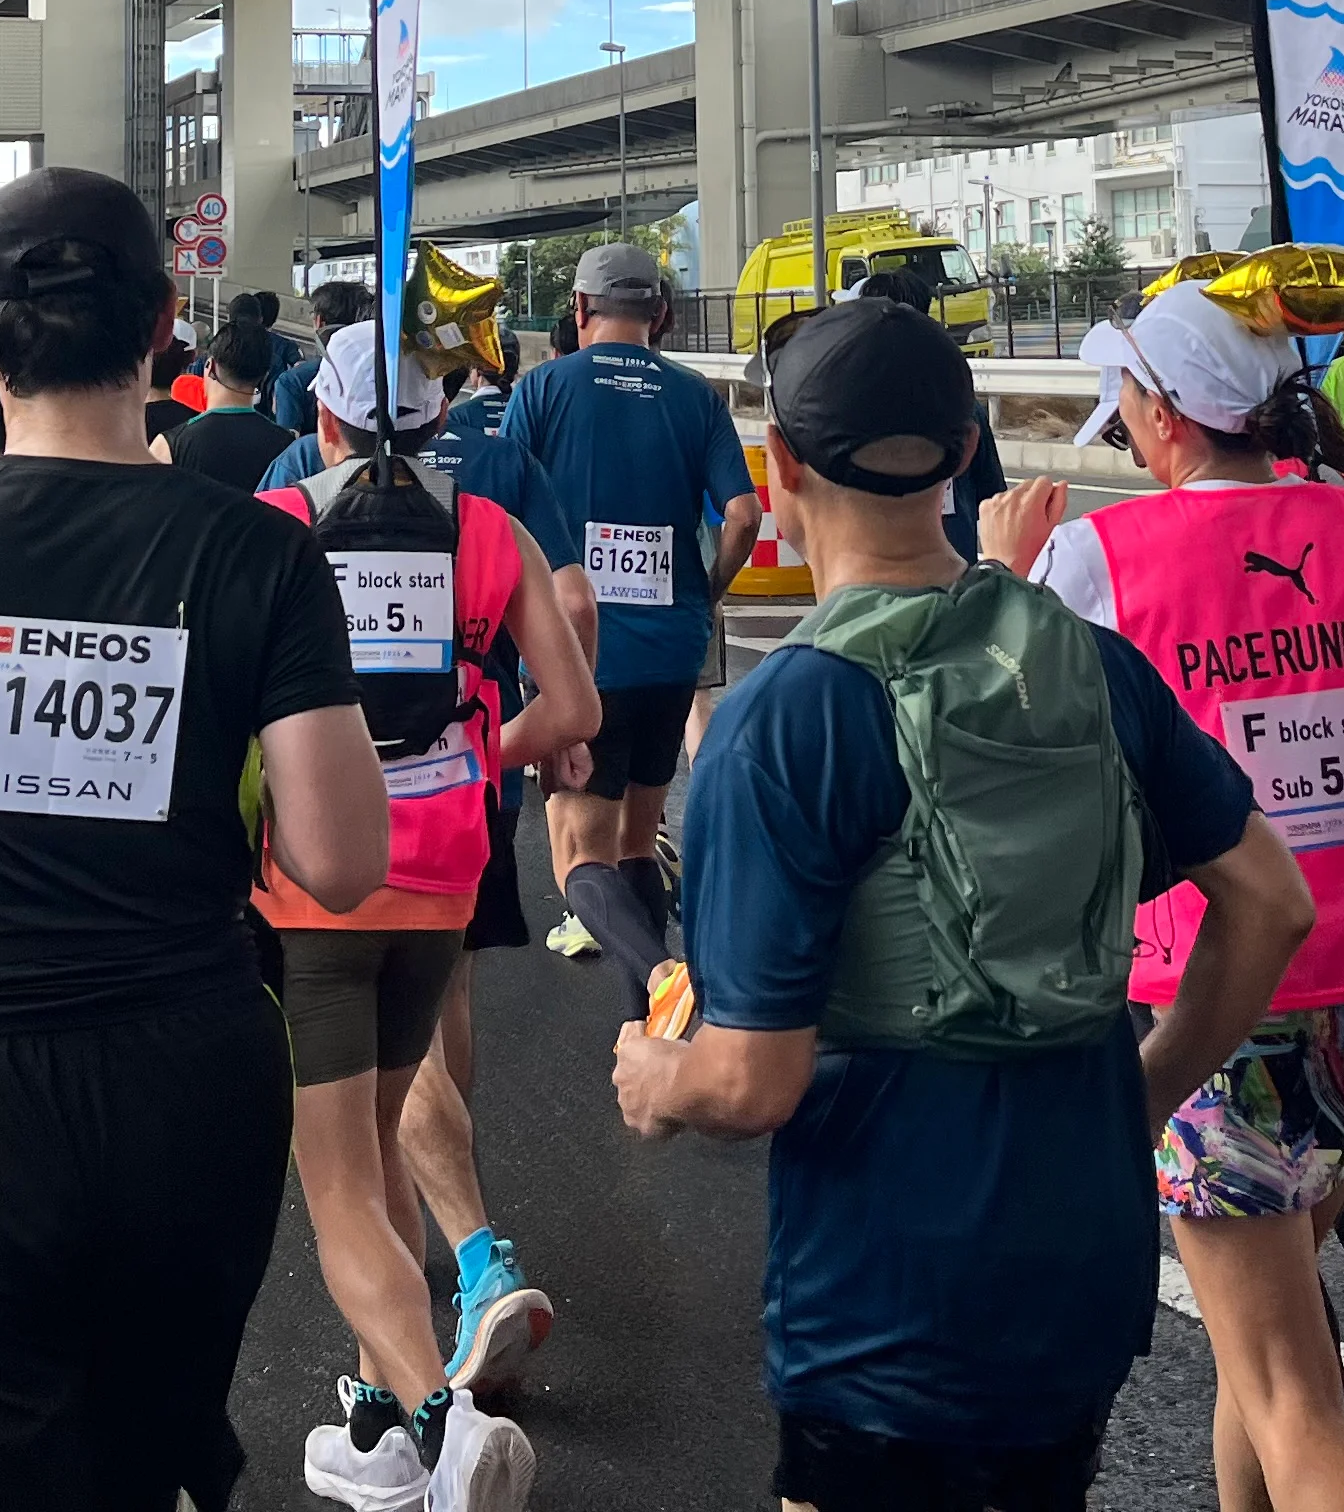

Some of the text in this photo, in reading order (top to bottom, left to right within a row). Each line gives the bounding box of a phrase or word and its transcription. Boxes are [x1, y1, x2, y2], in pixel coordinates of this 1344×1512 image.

[203, 202, 221, 216] 40
[613, 528, 662, 543] ENEOS
[589, 546, 670, 575] G16214
[357, 571, 402, 589] block
[408, 573, 445, 589] start
[600, 585, 658, 600] LAWSON
[345, 602, 423, 633] Sub 5 h
[19, 627, 152, 664] ENEOS
[1241, 711, 1266, 754] F
[1278, 716, 1334, 744] block
[1271, 774, 1314, 802] Sub
[1320, 755, 1344, 796] 5
